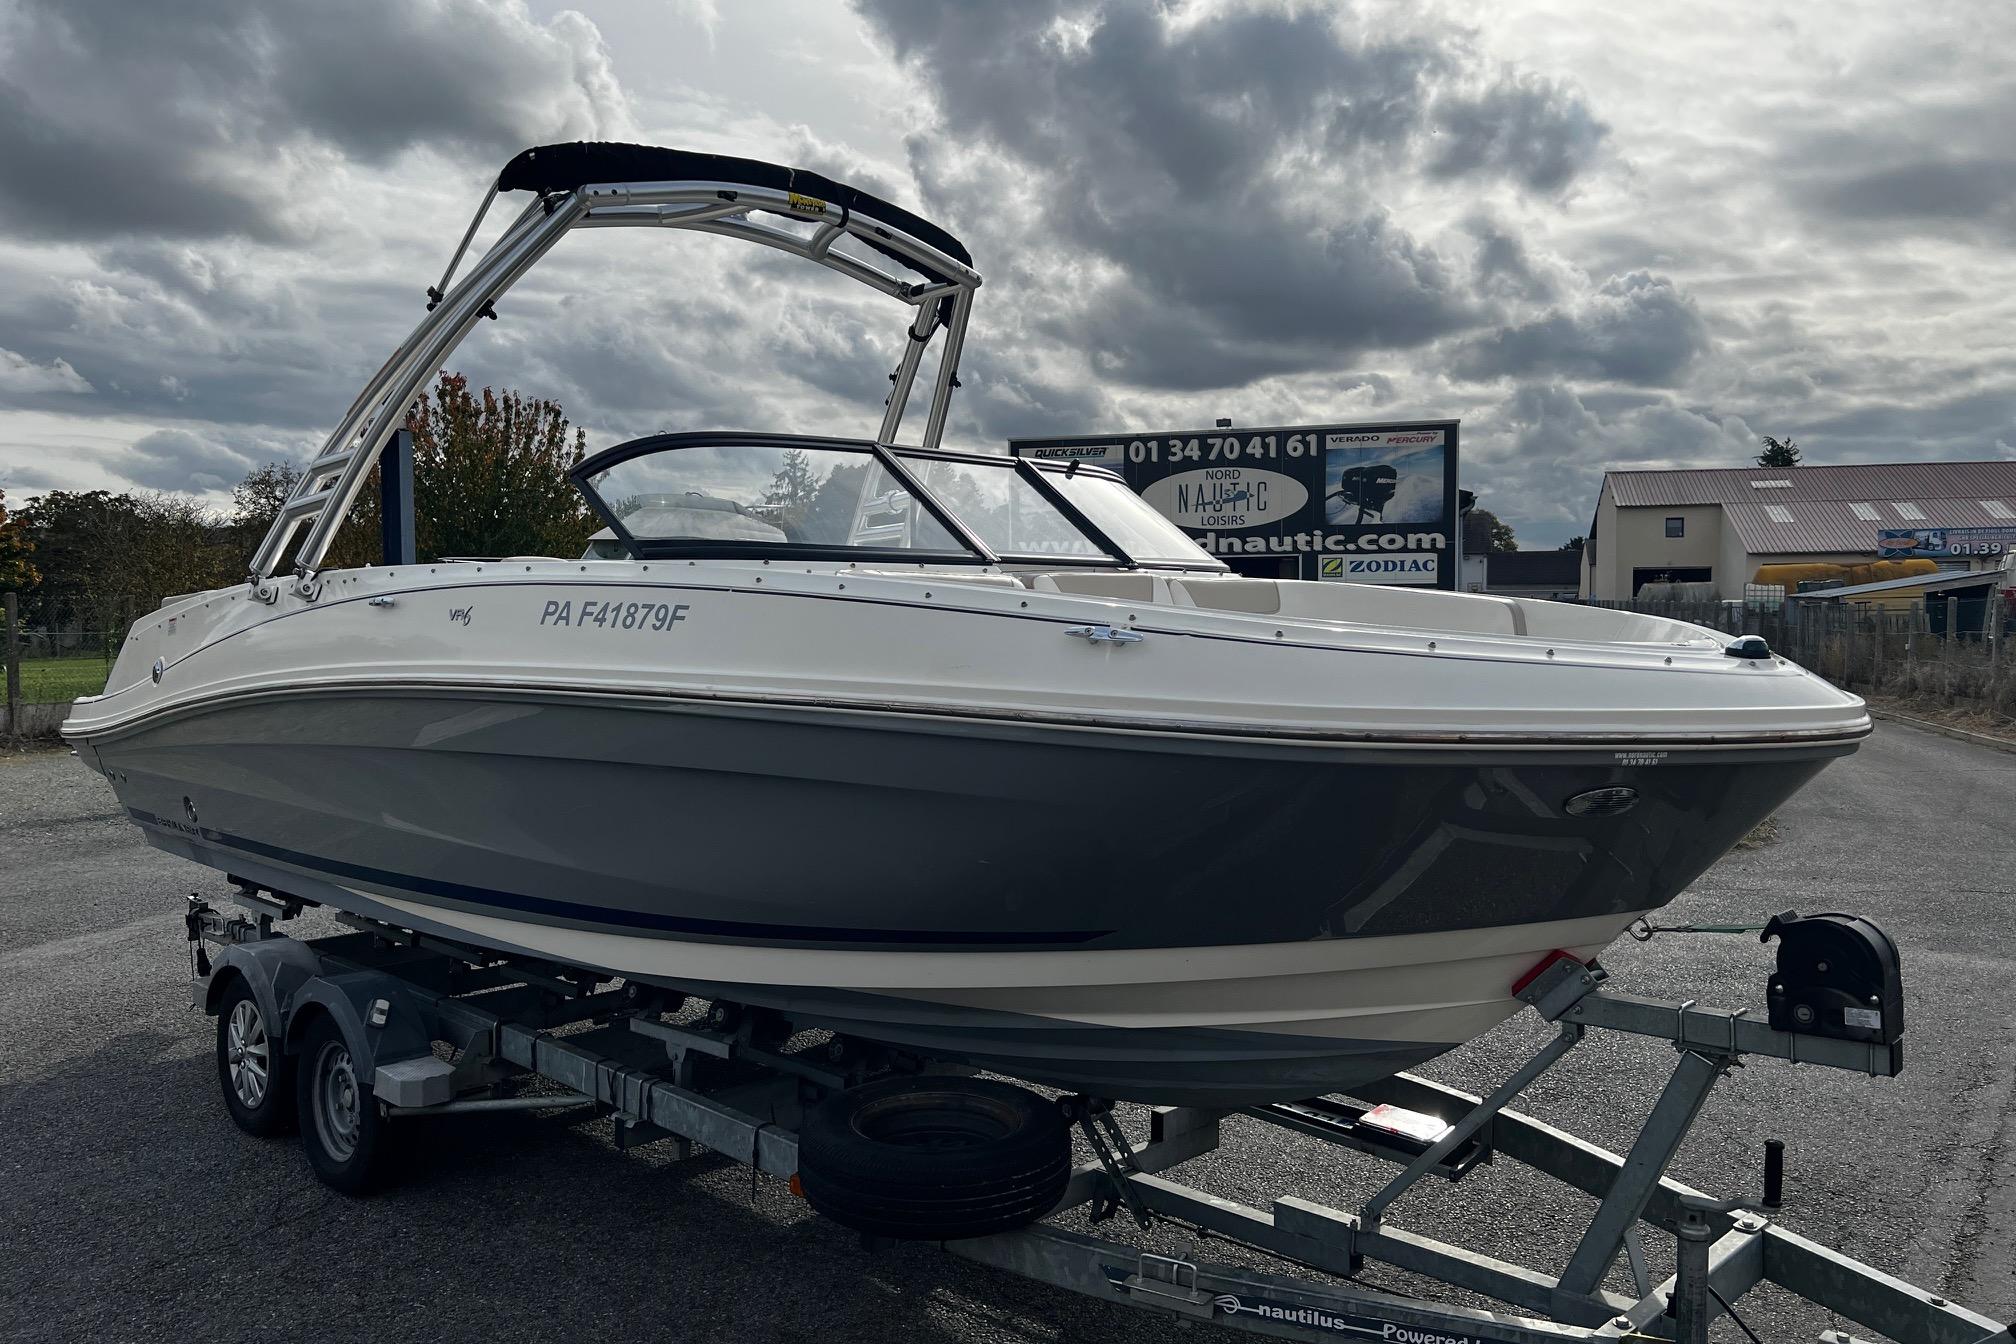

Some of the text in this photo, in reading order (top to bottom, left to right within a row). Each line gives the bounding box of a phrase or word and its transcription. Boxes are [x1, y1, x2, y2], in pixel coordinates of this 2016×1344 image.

[1331, 435, 1380, 443] VERADO
[1387, 435, 1438, 444] MERCURY
[1035, 447, 1109, 459] QUICKSILVER
[1129, 434, 1318, 463] 01 34 70 41 61
[1205, 469, 1241, 480] NORD
[1178, 481, 1267, 513] NAUTIC
[1201, 515, 1245, 526] LOISIRS
[1350, 558, 1435, 573] ZODIAC
[540, 600, 690, 631] PA F41879F
[1258, 1304, 1345, 1330] nautilus
